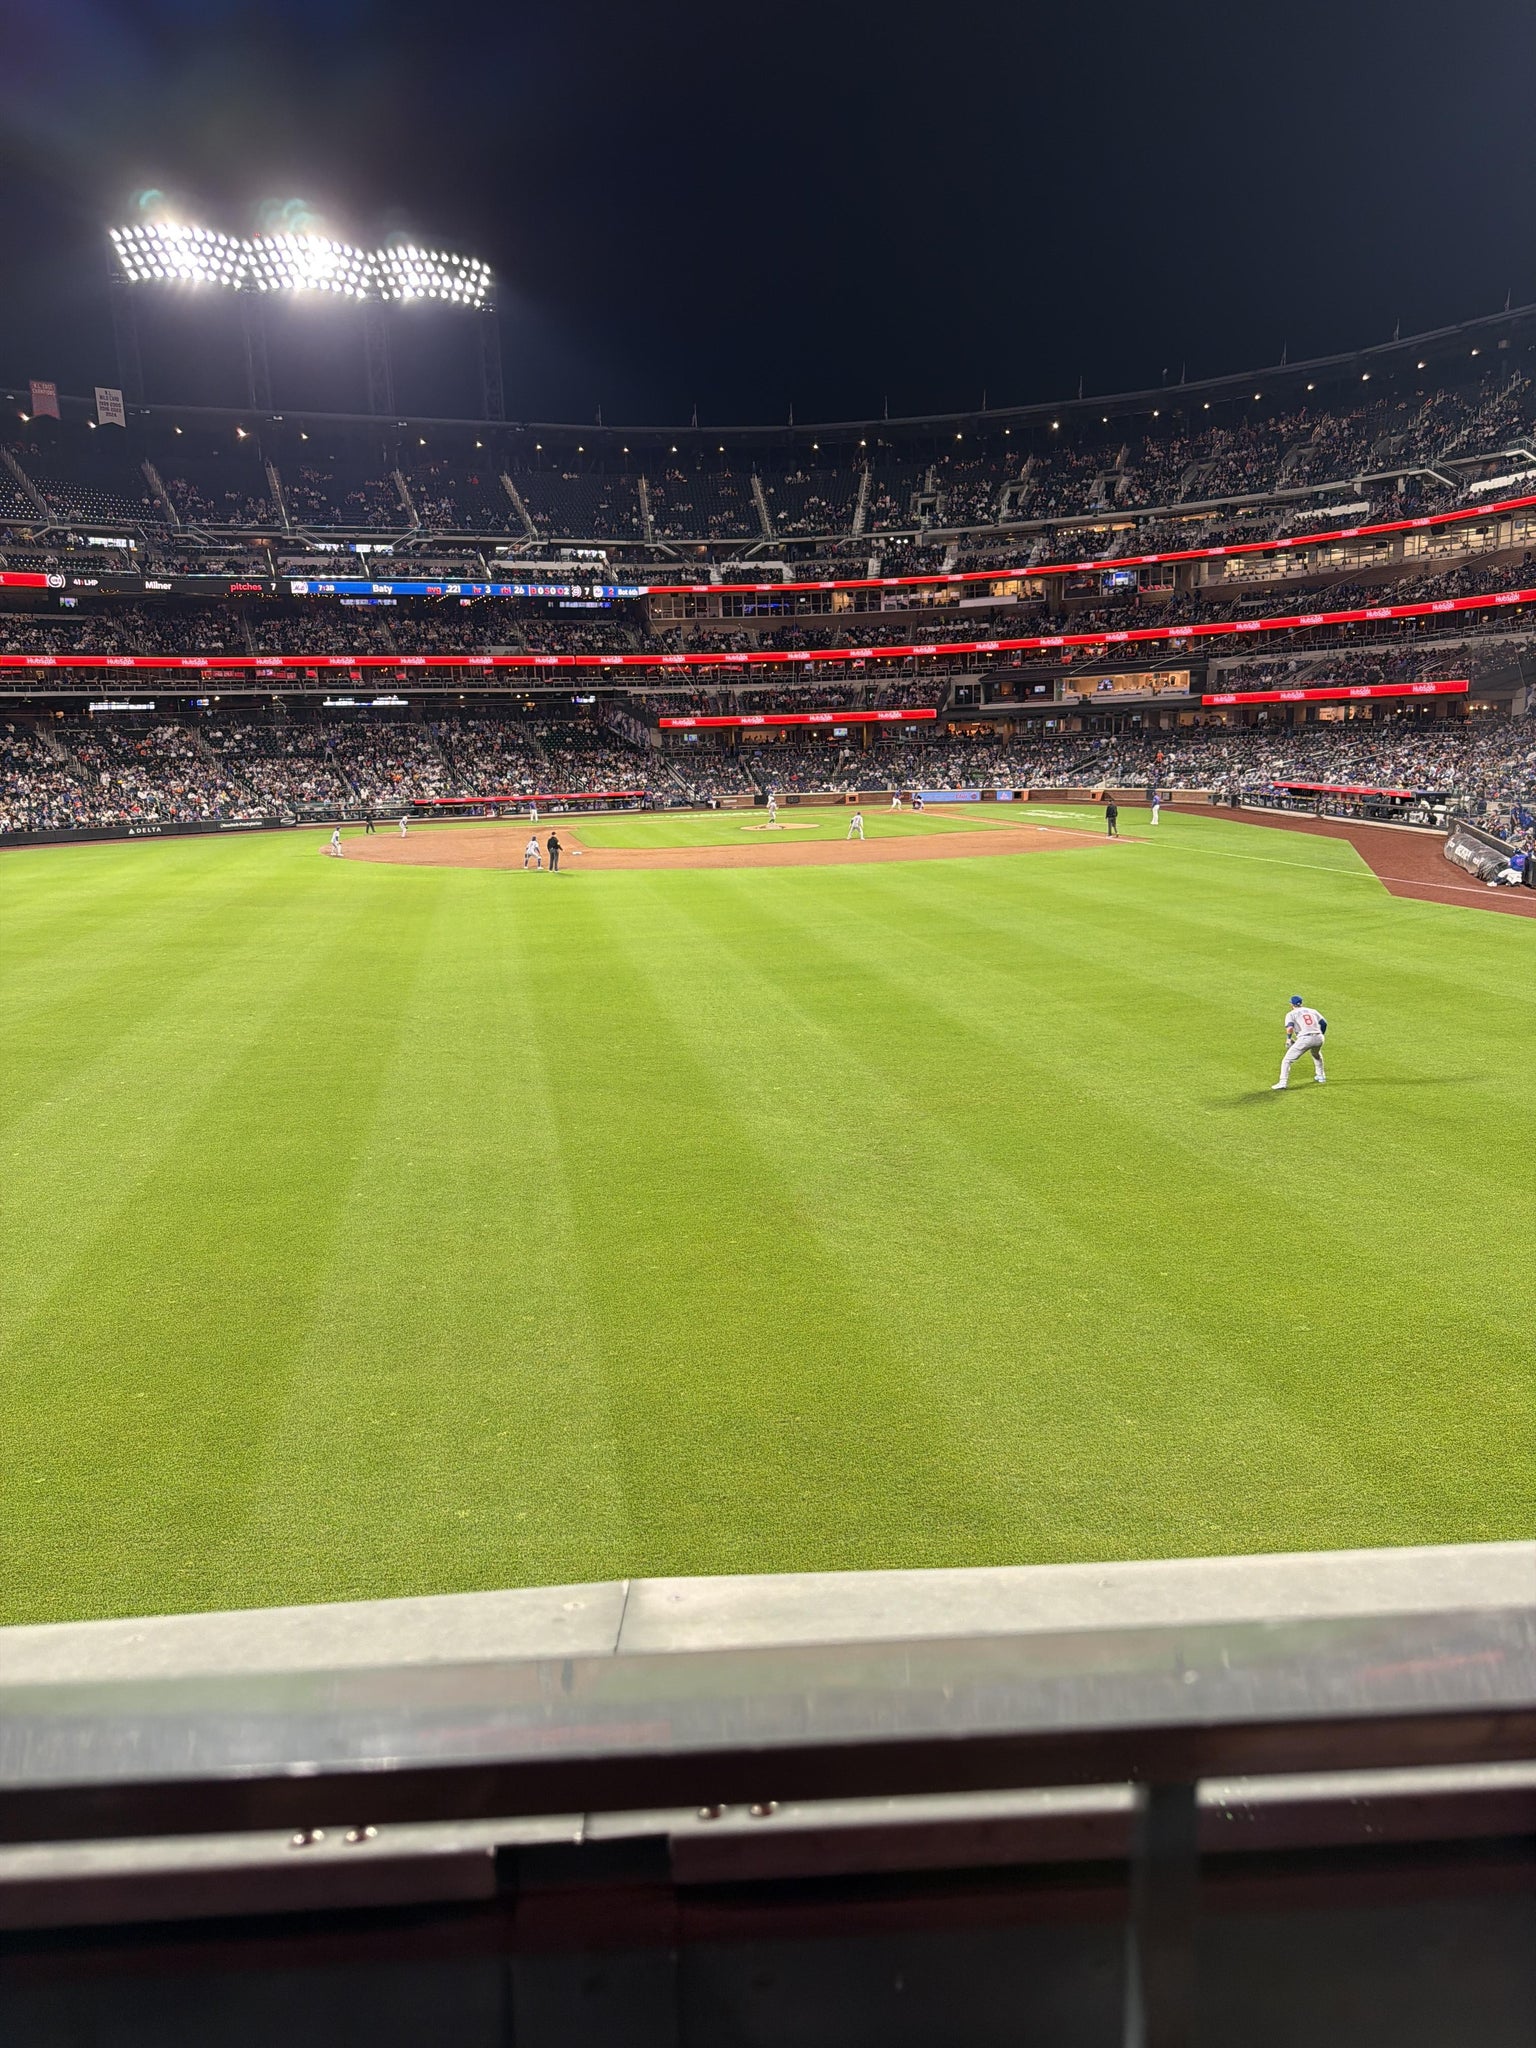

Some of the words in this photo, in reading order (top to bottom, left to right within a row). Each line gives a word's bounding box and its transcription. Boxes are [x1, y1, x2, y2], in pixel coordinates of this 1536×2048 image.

[145, 580, 172, 590] Milner
[230, 582, 262, 593] pitches
[270, 583, 276, 591] 7
[372, 584, 392, 594] Baty
[426, 586, 442, 595] avg
[446, 585, 461, 593] .221
[473, 585, 481, 594] hr
[485, 585, 491, 593] 3
[500, 586, 511, 594] rbi
[514, 585, 525, 594] 26
[584, 587, 590, 595] 7
[608, 588, 614, 596] 2
[1303, 1014, 1313, 1025] 8
